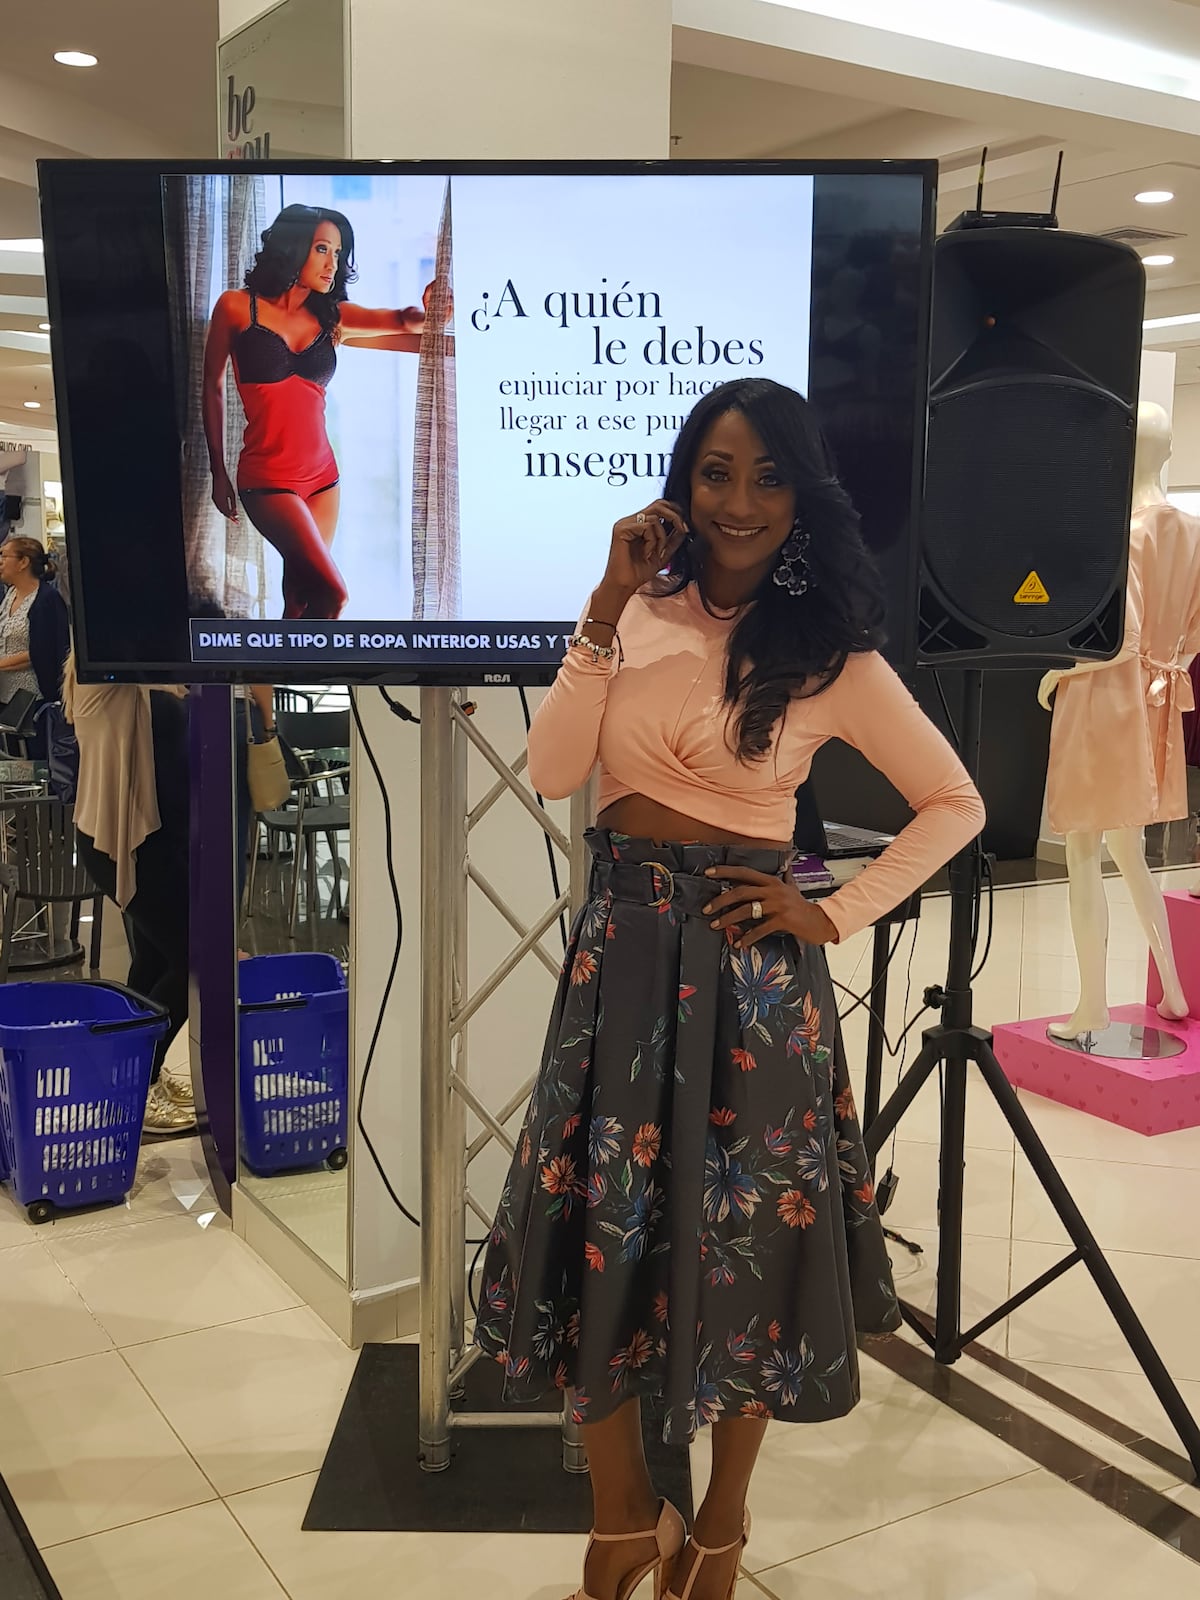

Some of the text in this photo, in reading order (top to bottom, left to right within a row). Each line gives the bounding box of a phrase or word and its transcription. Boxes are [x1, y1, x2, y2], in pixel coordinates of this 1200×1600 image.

[227, 75, 256, 142] be
[544, 277, 663, 328] quién
[592, 325, 765, 366] le debes
[499, 372, 607, 401] enjuiciar
[616, 379, 660, 401] por
[500, 406, 567, 435] llegar
[576, 414, 589, 431] a
[597, 414, 636, 431] ese
[199, 633, 241, 648] DIME
[247, 633, 283, 648] QUE
[288, 634, 327, 648] TIPO
[333, 634, 354, 648] DE
[359, 634, 408, 649] ROPA
[412, 634, 490, 649] INTERIOR
[496, 634, 541, 649] USAS
[546, 635, 559, 649] Y
[484, 674, 511, 682] RCA
